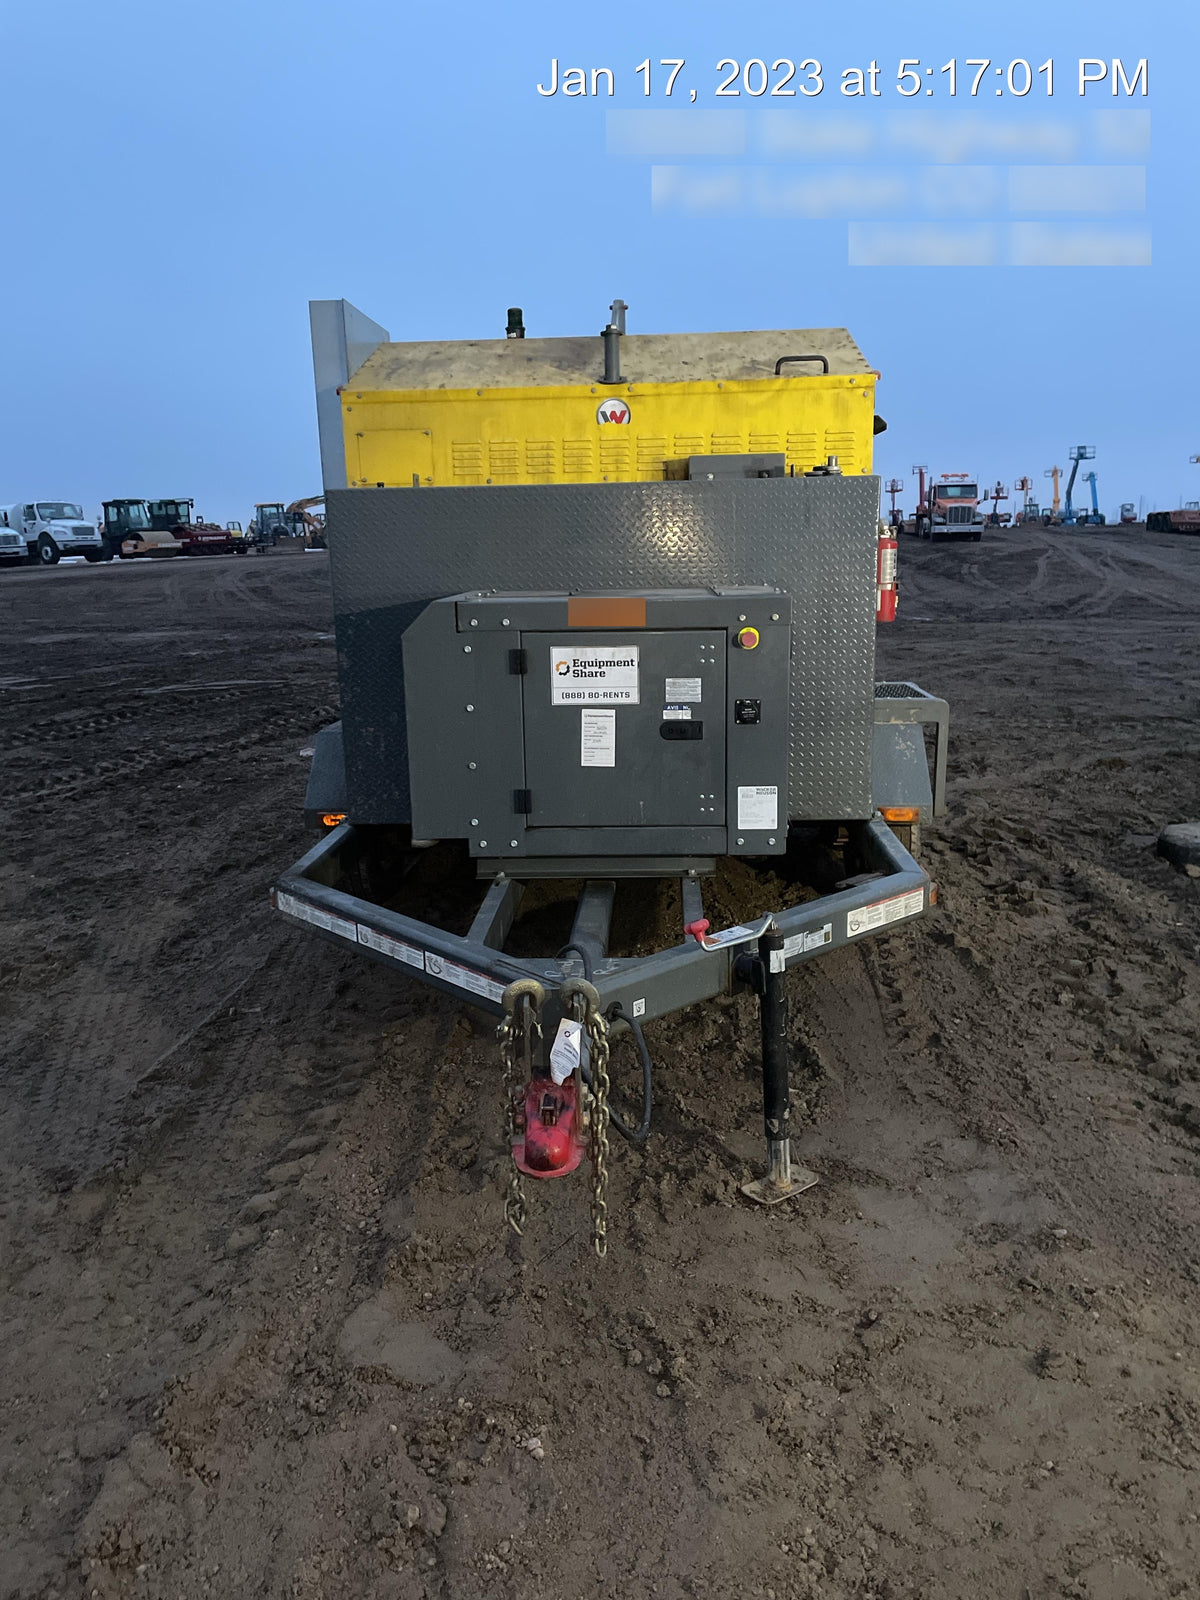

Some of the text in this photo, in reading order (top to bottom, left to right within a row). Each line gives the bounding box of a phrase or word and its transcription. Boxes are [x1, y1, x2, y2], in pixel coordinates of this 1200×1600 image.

[572, 659, 635, 669] Equipment
[572, 669, 606, 678] Share
[561, 691, 631, 700] (888) 80-RENTS
